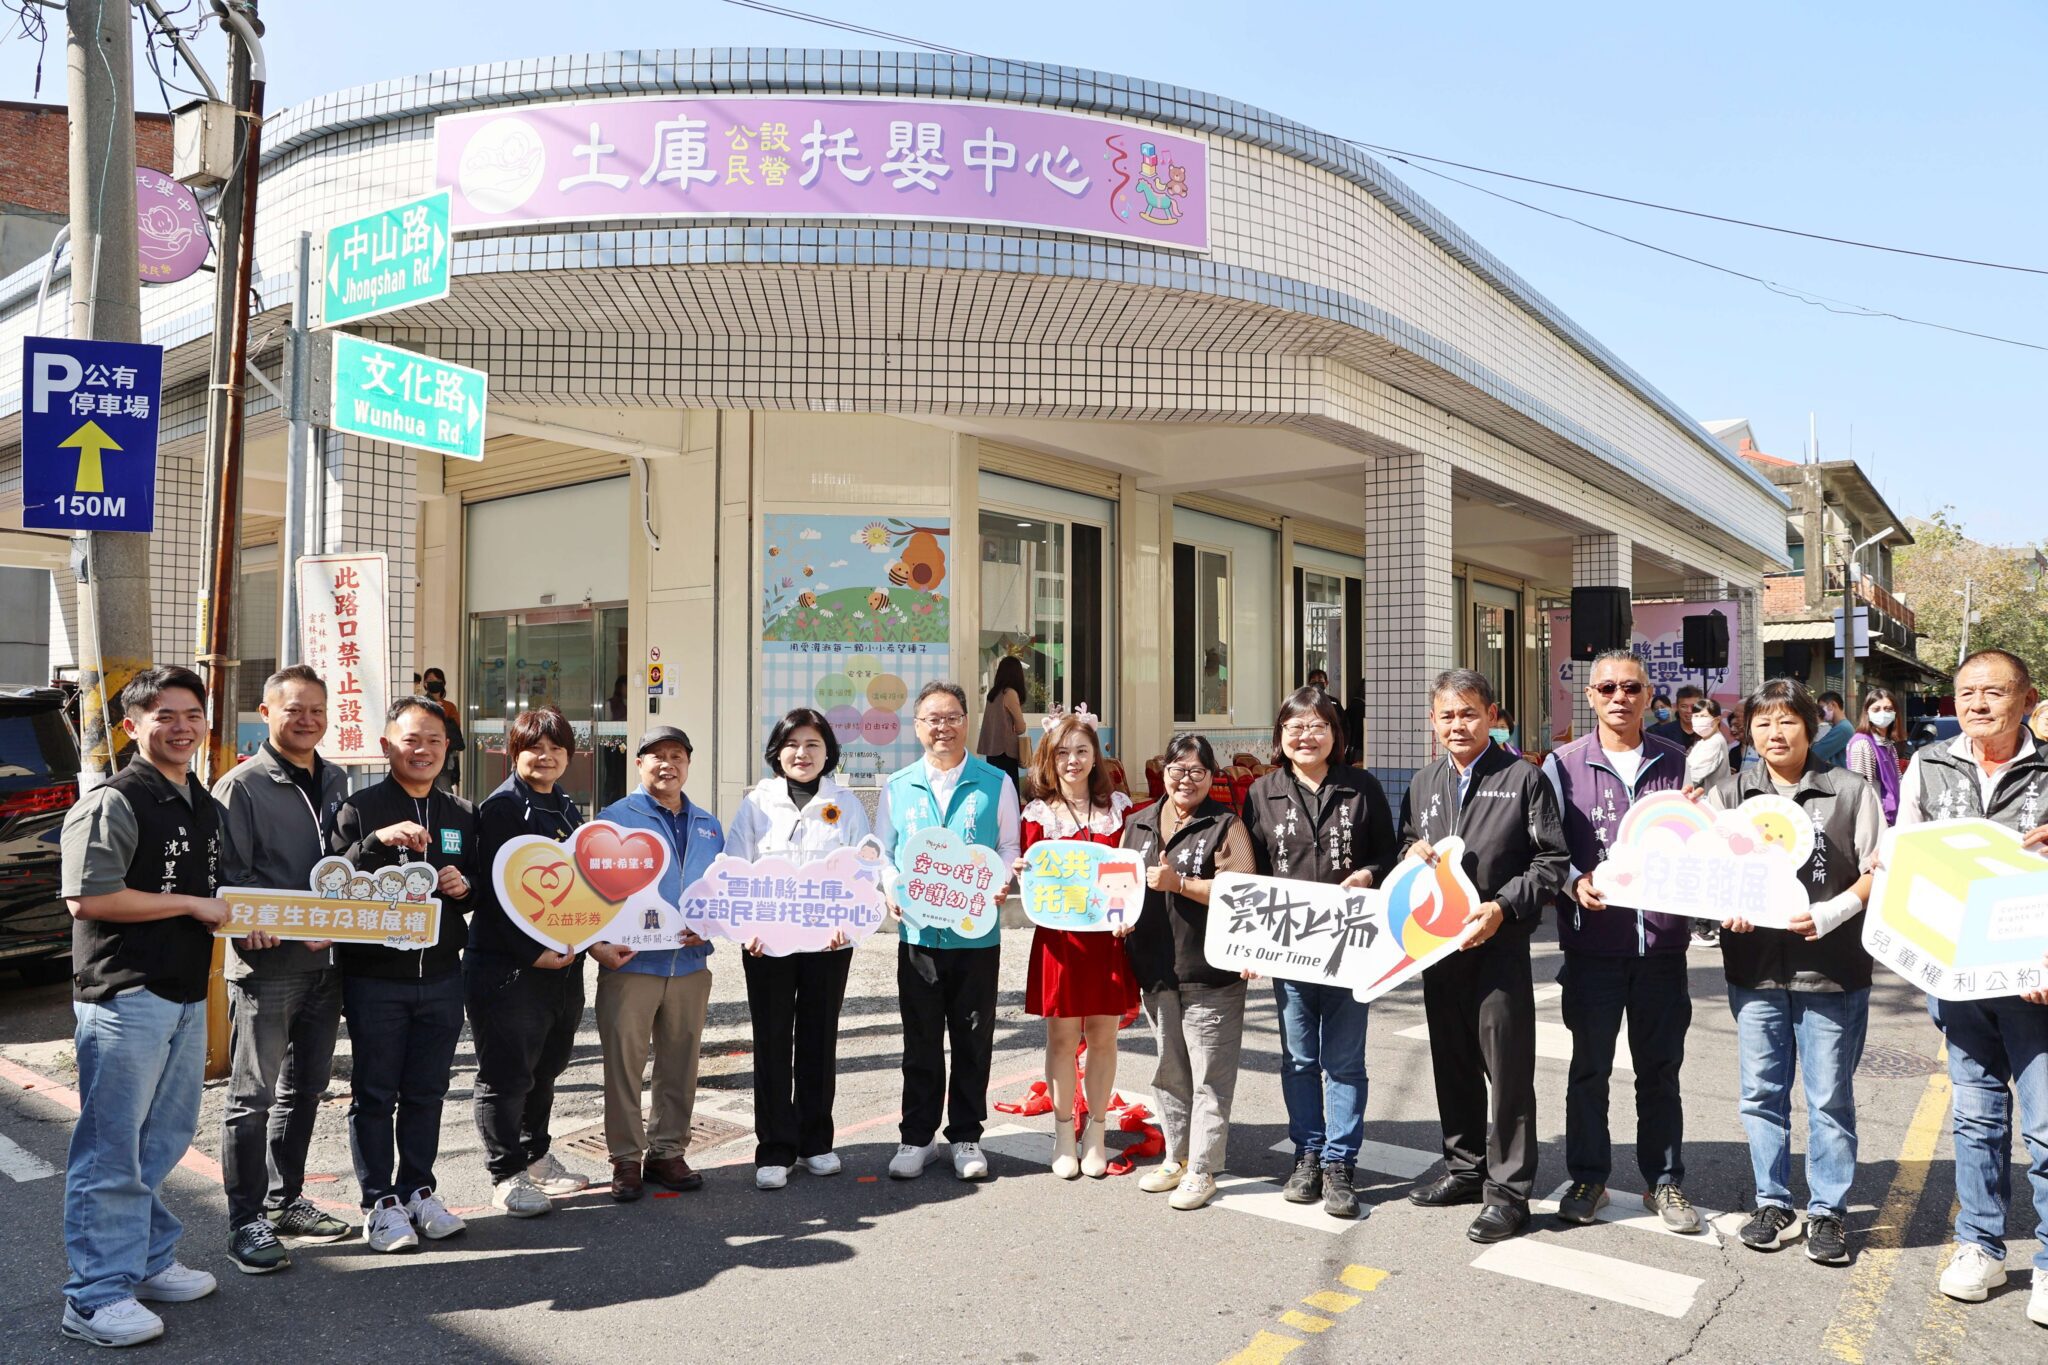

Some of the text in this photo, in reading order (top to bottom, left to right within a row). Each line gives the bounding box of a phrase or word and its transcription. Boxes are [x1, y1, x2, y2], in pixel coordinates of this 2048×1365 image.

[558, 113, 719, 193] 土庫
[725, 121, 790, 153] 公設
[725, 154, 790, 187] 民營
[798, 117, 1091, 195] 托嬰中心
[343, 205, 431, 272] 中山路
[342, 260, 433, 307] Jhongshan Rd.
[33, 352, 82, 413] P
[84, 364, 138, 391] 公有
[360, 352, 466, 413] 文化路
[69, 392, 150, 420] 停車場
[353, 397, 465, 446] Wunhua Rd.
[54, 494, 126, 518] 150M
[334, 566, 364, 752] 此路口禁止設攤
[912, 852, 993, 891] 安心托育
[1034, 849, 1092, 880] 公共
[1643, 850, 1769, 914] 兒童發展
[721, 875, 850, 900] 雲林縣土庫
[908, 878, 986, 917] 守護幼童
[1032, 883, 1090, 915] 托育
[230, 902, 428, 932] 兒童生存及發展權
[546, 911, 602, 927] 公益彩券
[685, 898, 881, 928] 公設民營托嬰中心
[1226, 943, 1321, 967] It's Our Time
[1869, 929, 2041, 993] 兒童權利公約
